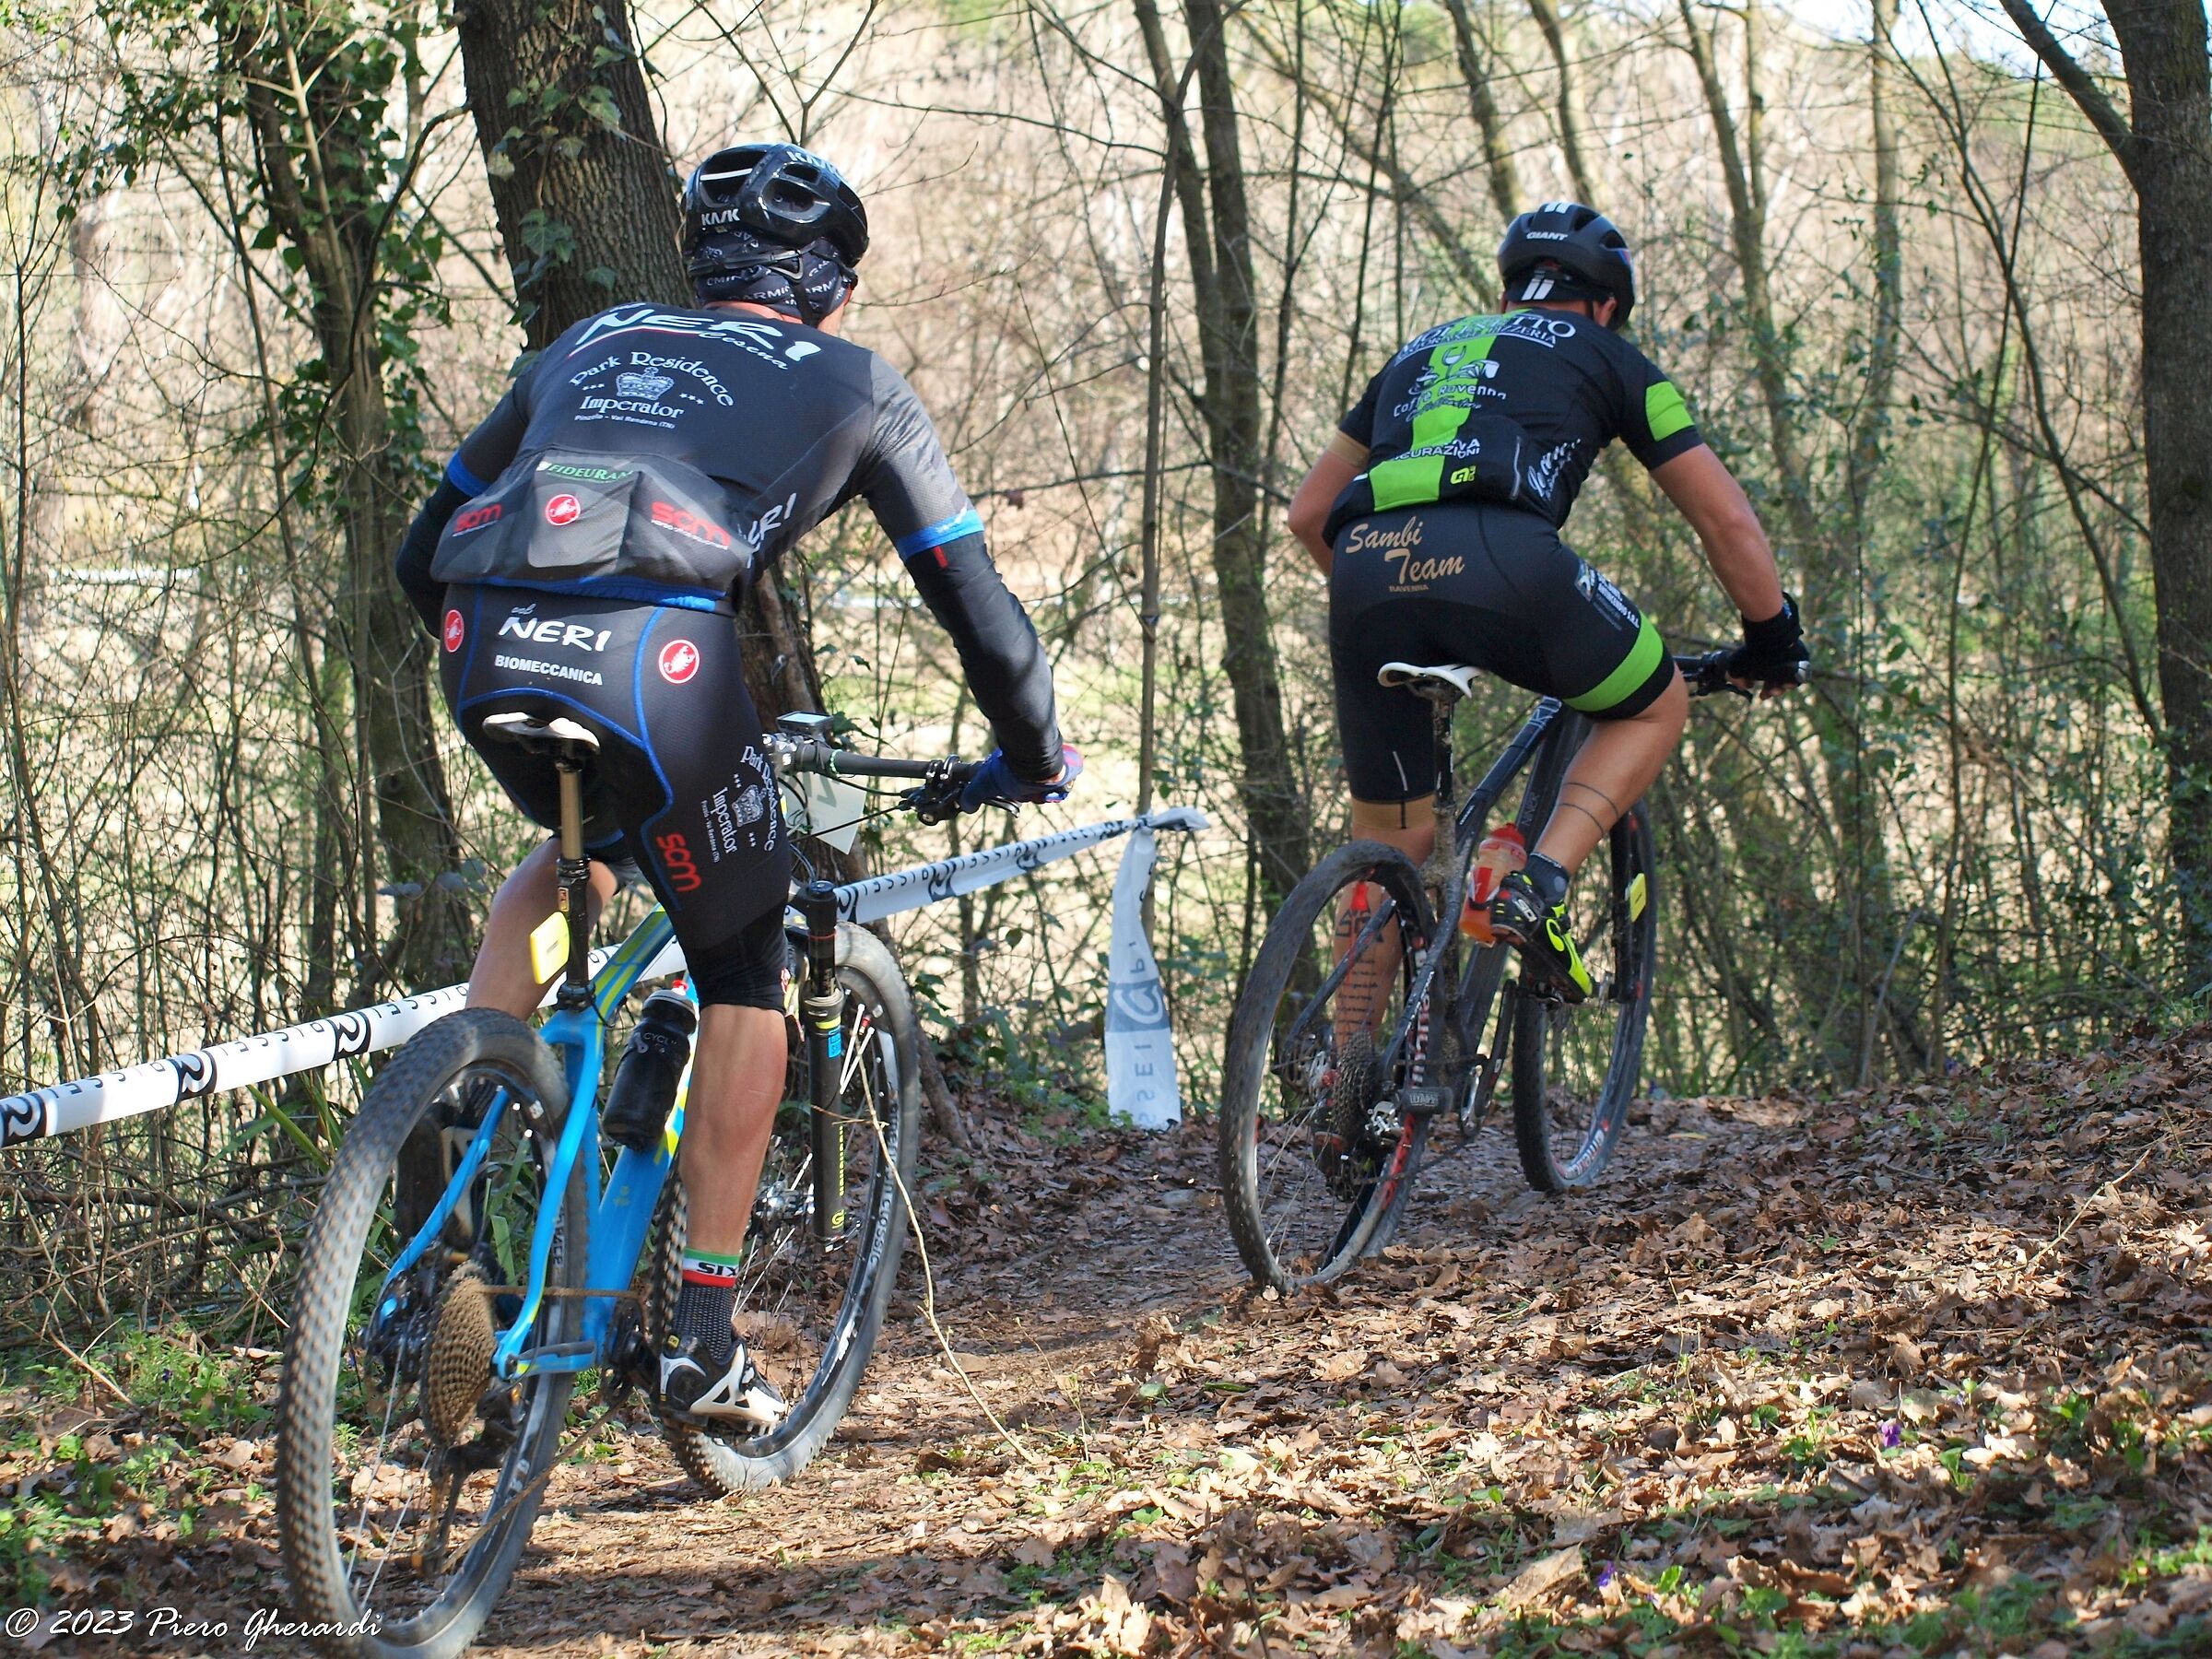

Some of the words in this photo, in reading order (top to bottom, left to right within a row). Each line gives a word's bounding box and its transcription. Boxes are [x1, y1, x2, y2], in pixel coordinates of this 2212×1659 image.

[1526, 231, 1569, 241] GIANT
[575, 309, 822, 362] NERI
[698, 330, 789, 370] Cesena
[569, 356, 621, 385] Park
[629, 351, 734, 407] Residence
[580, 395, 685, 418] Imperator
[1346, 516, 1423, 553] Sambi
[1384, 547, 1465, 584] Team
[499, 617, 612, 652] NERI
[495, 654, 603, 686] BIOMECCANICA
[740, 746, 763, 772] Park
[711, 786, 738, 853] Imperator
[656, 833, 702, 892] scm
